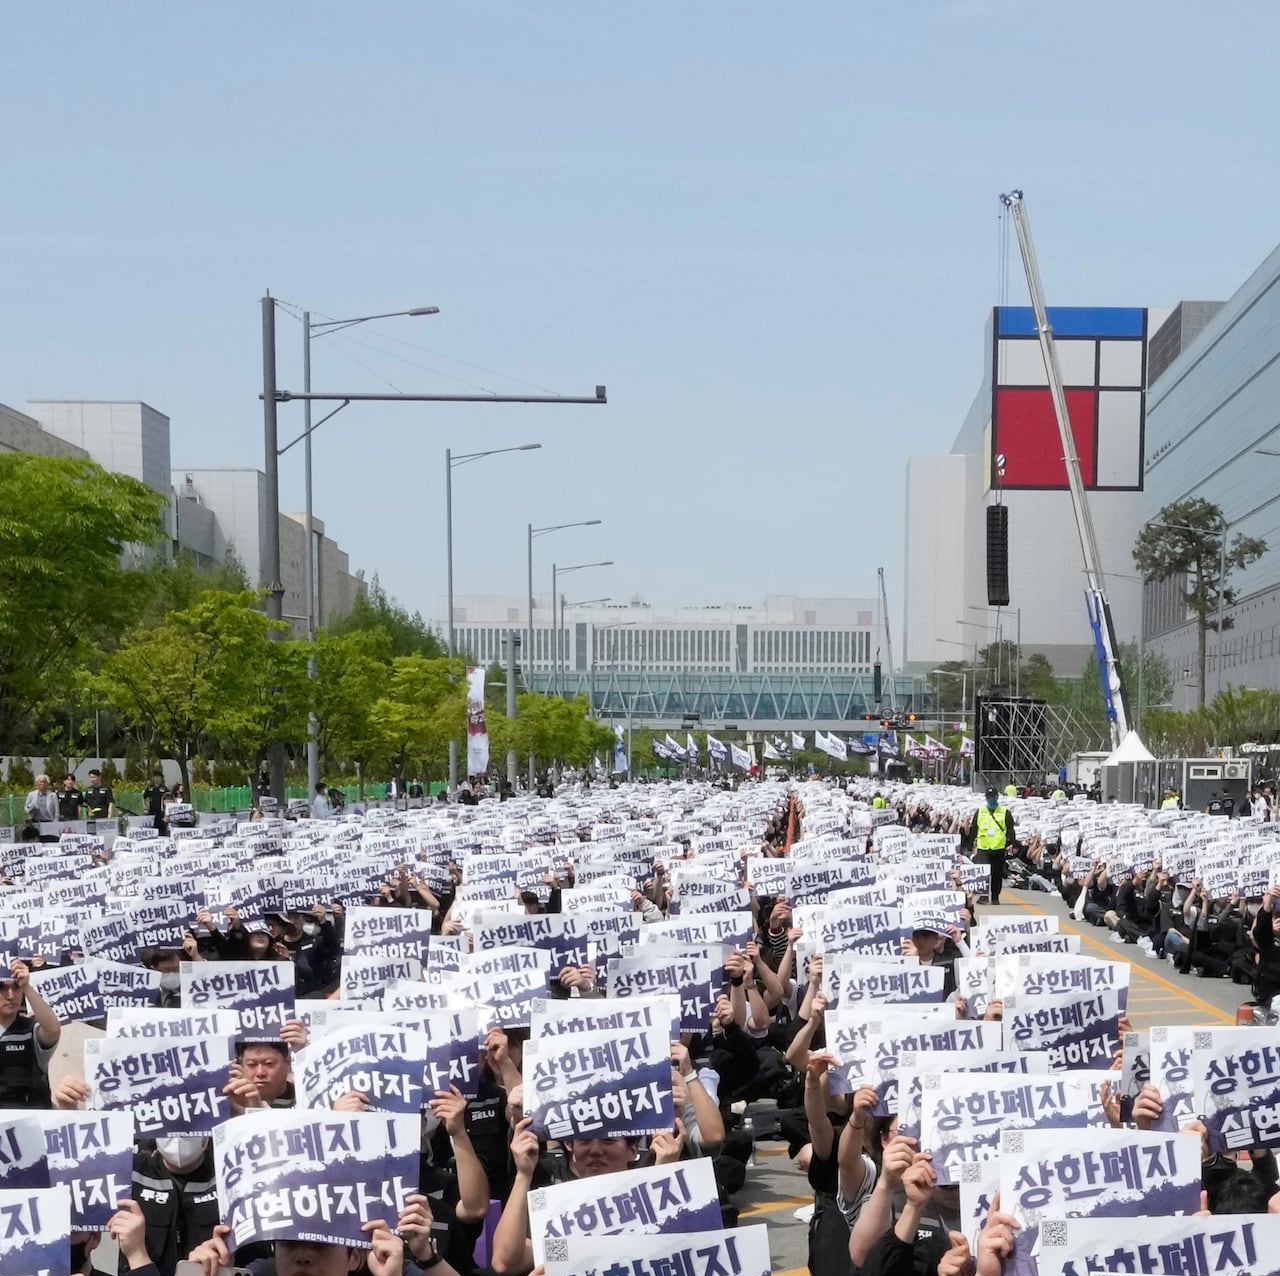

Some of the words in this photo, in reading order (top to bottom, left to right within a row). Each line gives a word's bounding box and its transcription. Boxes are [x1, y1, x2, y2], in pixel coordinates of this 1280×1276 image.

[351, 913, 420, 938] 상한폐지
[479, 916, 551, 948] 상한폐지
[821, 912, 890, 944] 상한폐지
[188, 965, 280, 1003] 상한폐지
[345, 960, 411, 988] 상한폐지
[614, 964, 698, 998] 상한폐지
[846, 969, 930, 1001] 상한폐지
[1010, 997, 1105, 1042] 상한폐지
[93, 1042, 209, 1091] 상한폐지
[302, 1032, 408, 1090] 상한폐지
[531, 1030, 651, 1091] 상한폐지
[543, 1081, 672, 1139] 실현하자
[933, 1081, 1067, 1130] 상한폐지
[223, 1119, 360, 1189] 상한폐지
[1016, 1139, 1177, 1207] 상한폐지
[233, 1183, 383, 1245] 실현하자
